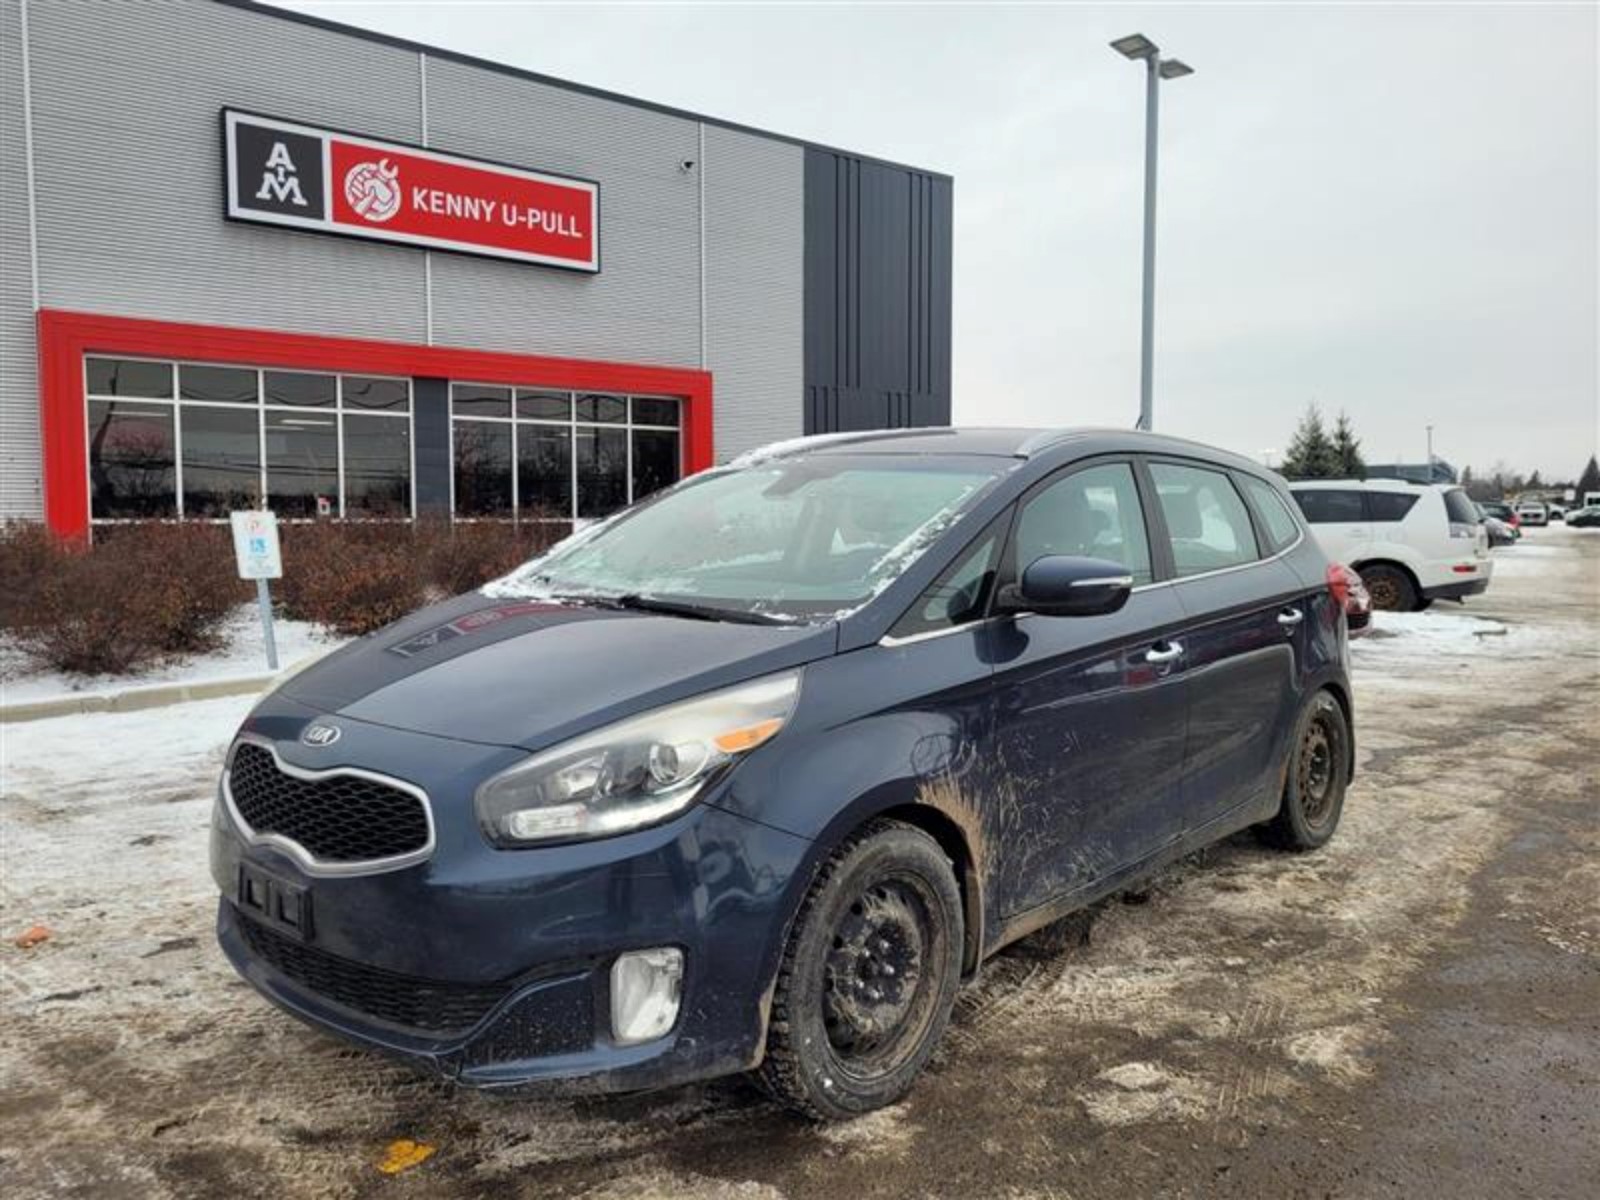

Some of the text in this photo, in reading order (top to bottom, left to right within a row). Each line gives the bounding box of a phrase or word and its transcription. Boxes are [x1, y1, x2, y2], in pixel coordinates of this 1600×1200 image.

[412, 186, 582, 238] KENNY U-PULL
[305, 726, 335, 743] KIA
